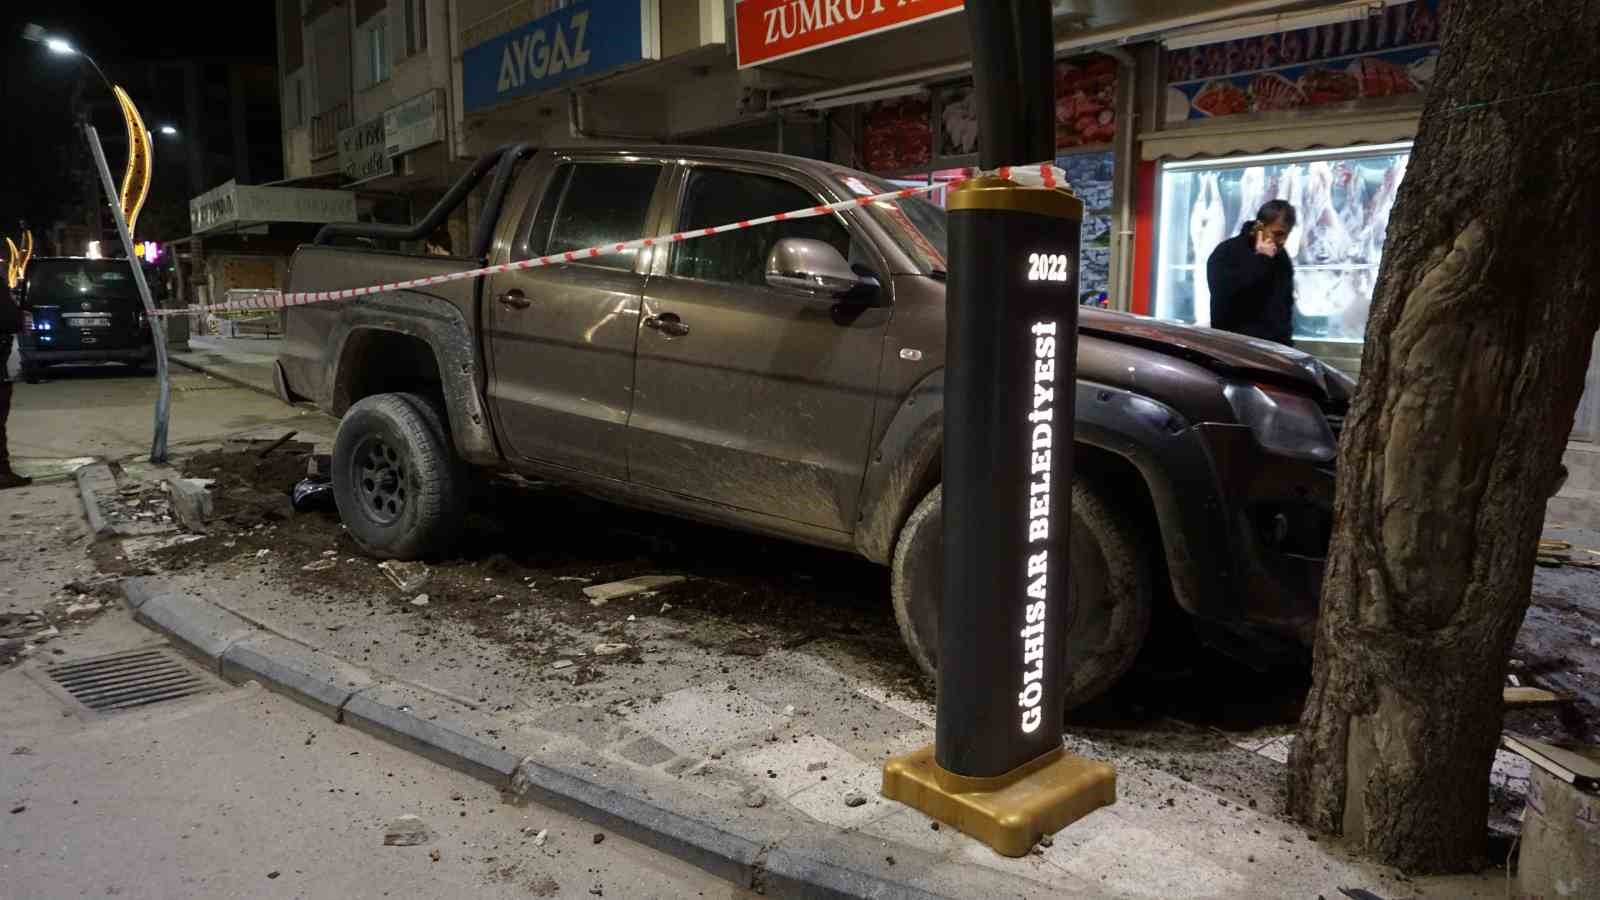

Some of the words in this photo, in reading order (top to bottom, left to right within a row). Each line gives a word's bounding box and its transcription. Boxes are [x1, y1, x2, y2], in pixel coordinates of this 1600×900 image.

[496, 11, 592, 94] AYGAZ
[1028, 252, 1068, 282] 2022
[1028, 321, 1057, 543] BELEDİYESİ
[1019, 550, 1048, 734] GÖLHİSAR
